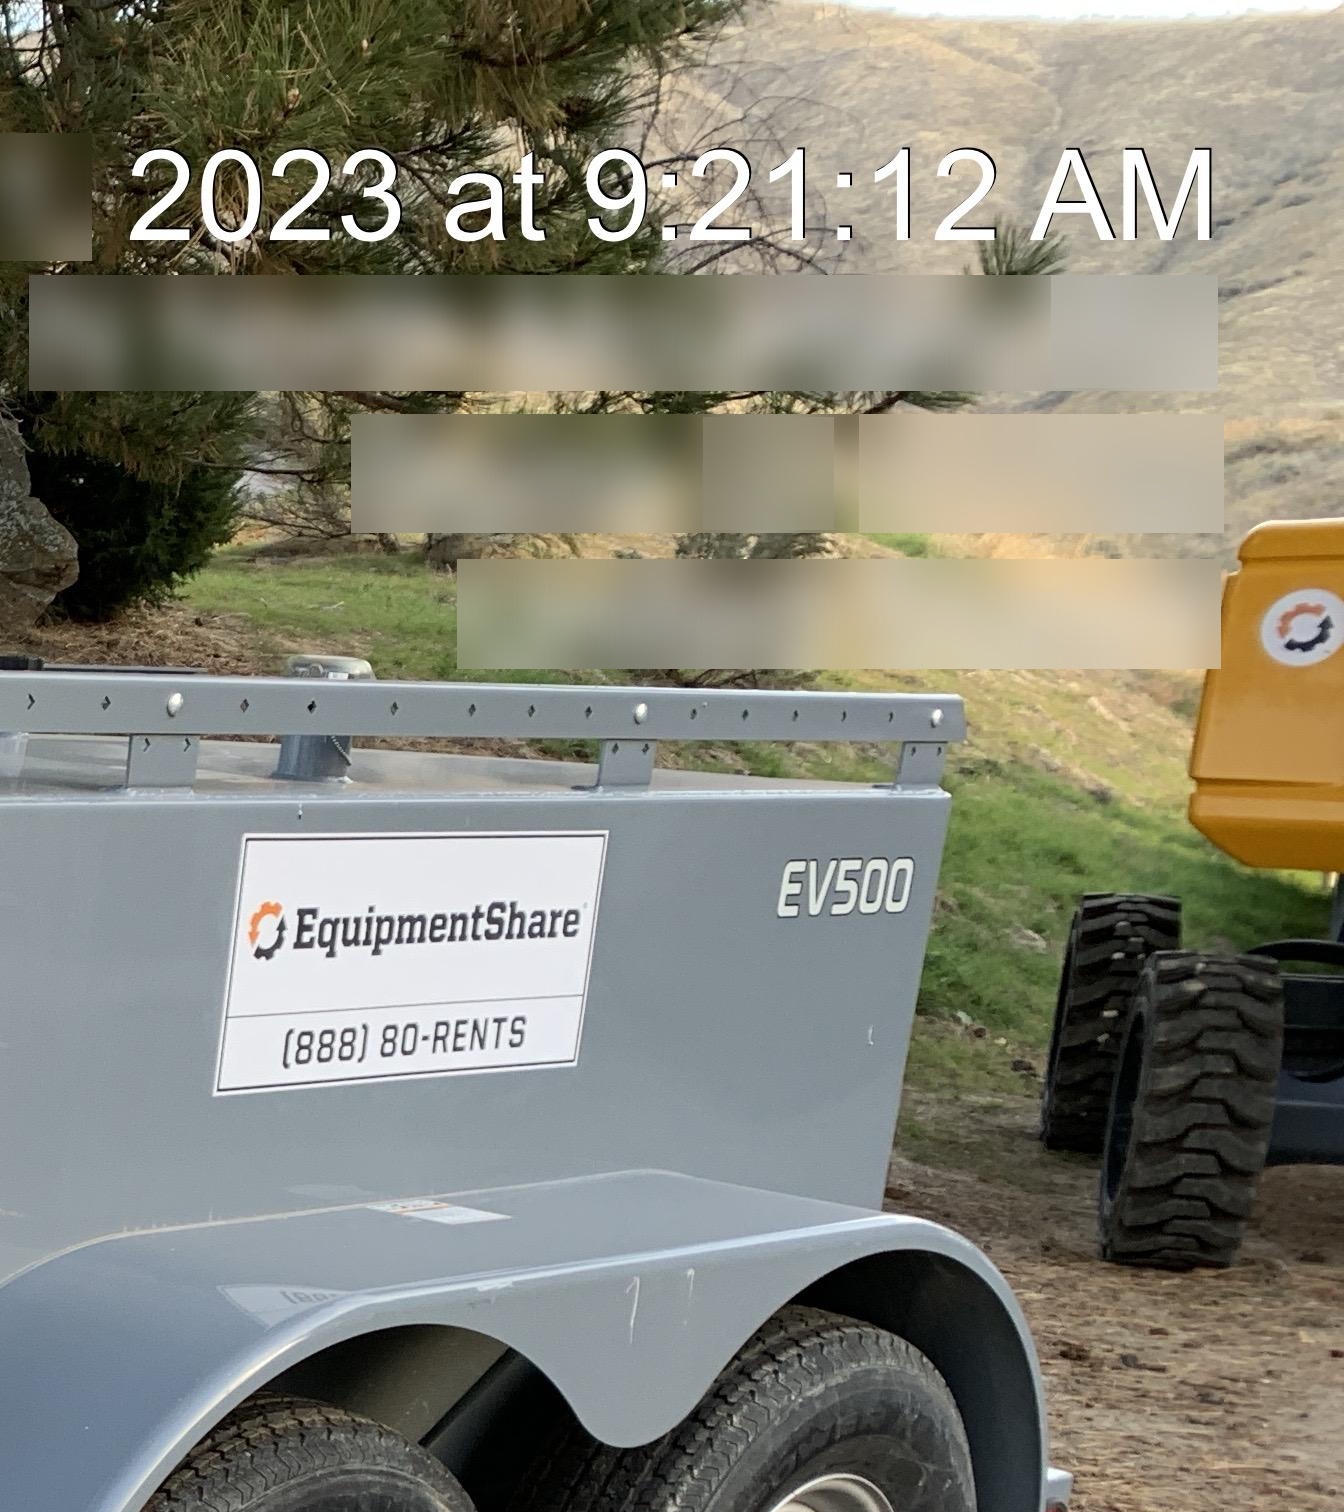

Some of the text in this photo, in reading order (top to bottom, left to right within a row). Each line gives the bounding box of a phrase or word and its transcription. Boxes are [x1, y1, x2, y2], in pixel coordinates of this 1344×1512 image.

[777, 857, 915, 918] EV500
[293, 901, 580, 957] EquipmentShare
[281, 1015, 527, 1069] (888) 80-RENTS
